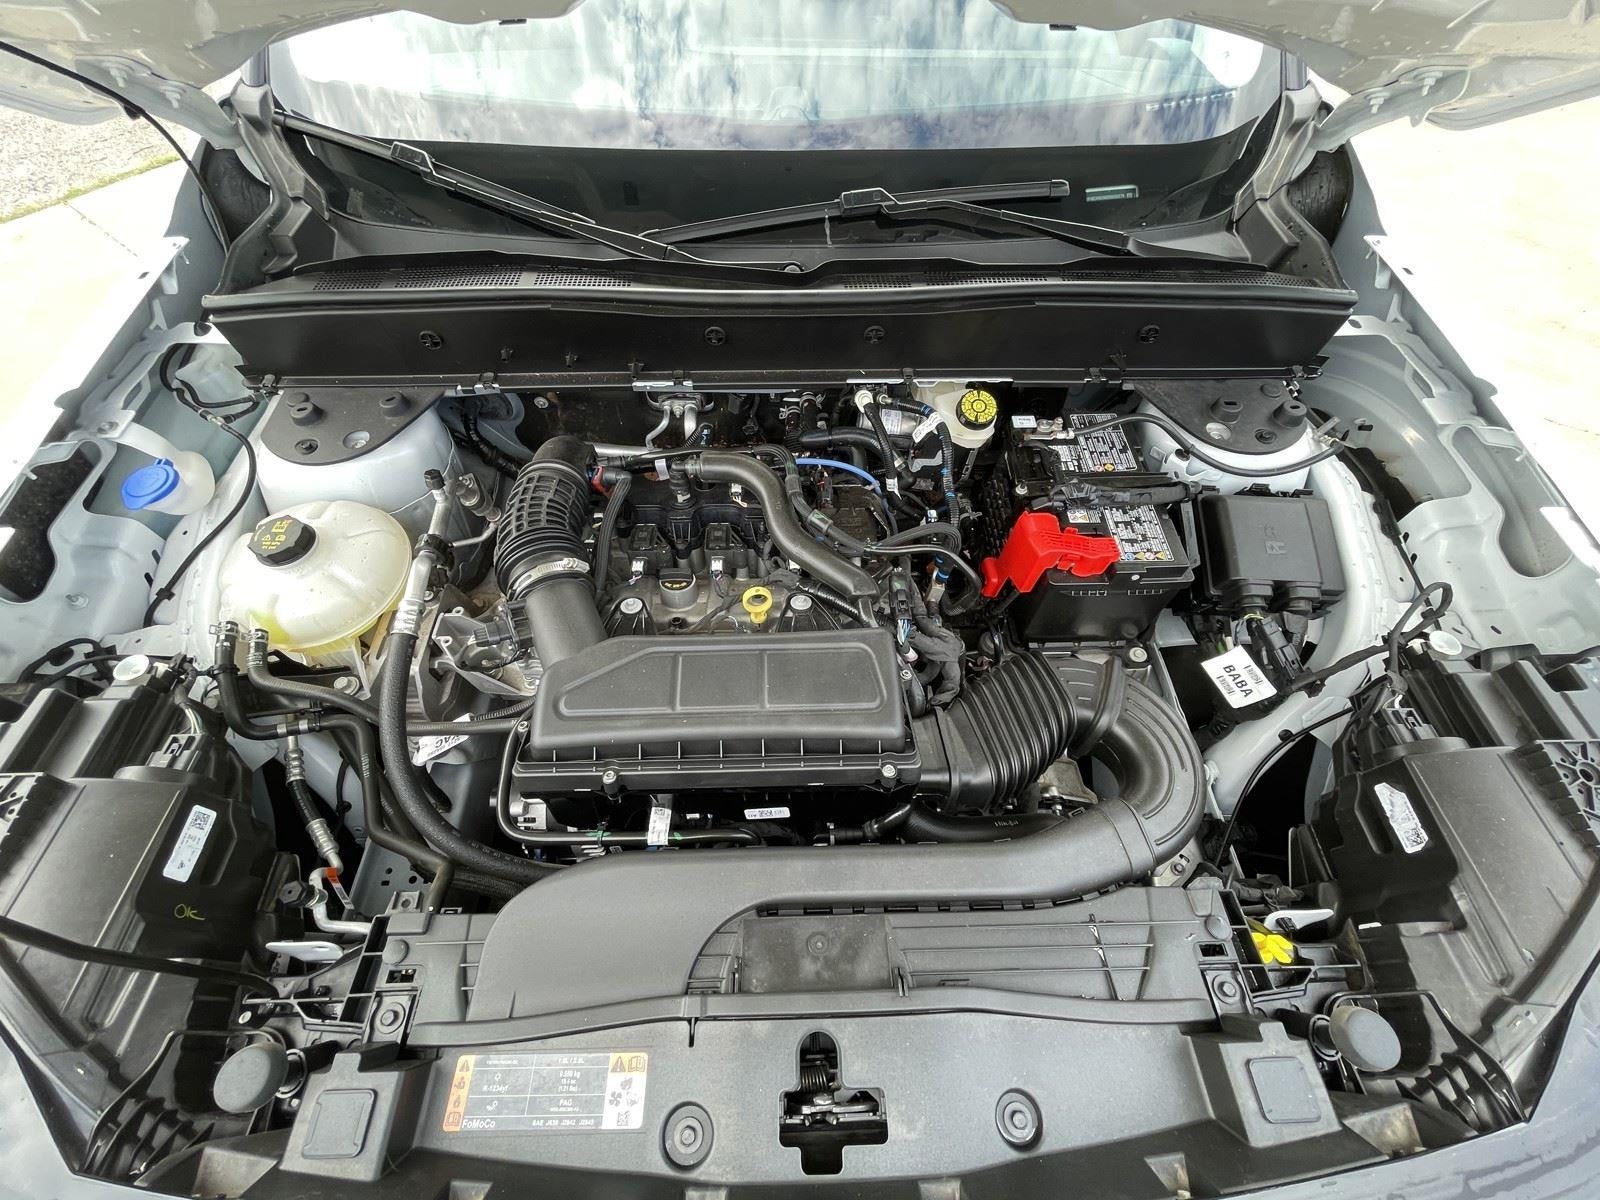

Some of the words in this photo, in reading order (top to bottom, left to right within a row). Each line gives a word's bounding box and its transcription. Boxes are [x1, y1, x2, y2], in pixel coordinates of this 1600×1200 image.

[1223, 665, 1254, 698] BABA
[482, 1084, 510, 1094] R-1234yf
[461, 1118, 496, 1129] FoMoCo
